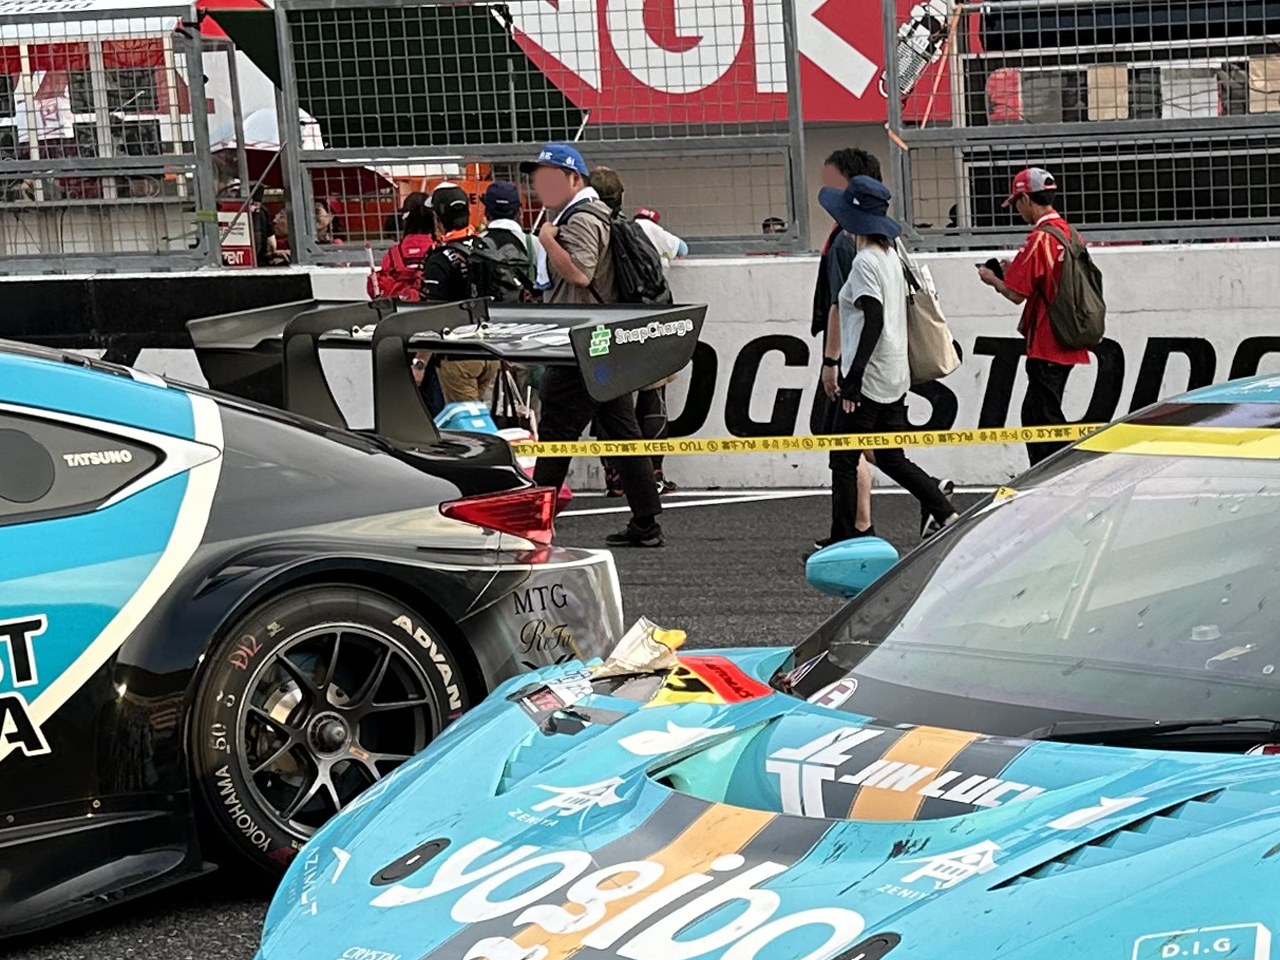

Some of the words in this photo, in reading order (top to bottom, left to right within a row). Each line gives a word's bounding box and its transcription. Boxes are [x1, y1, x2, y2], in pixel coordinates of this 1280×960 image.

[615, 319, 693, 344] SnapCharge
[64, 449, 132, 467] TATSUNO
[512, 583, 568, 615] MTG
[392, 614, 463, 711] ADVAN
[837, 759, 939, 792] JIN
[214, 764, 273, 853] YOKOHAMA
[1161, 937, 1232, 959] D.I.G
